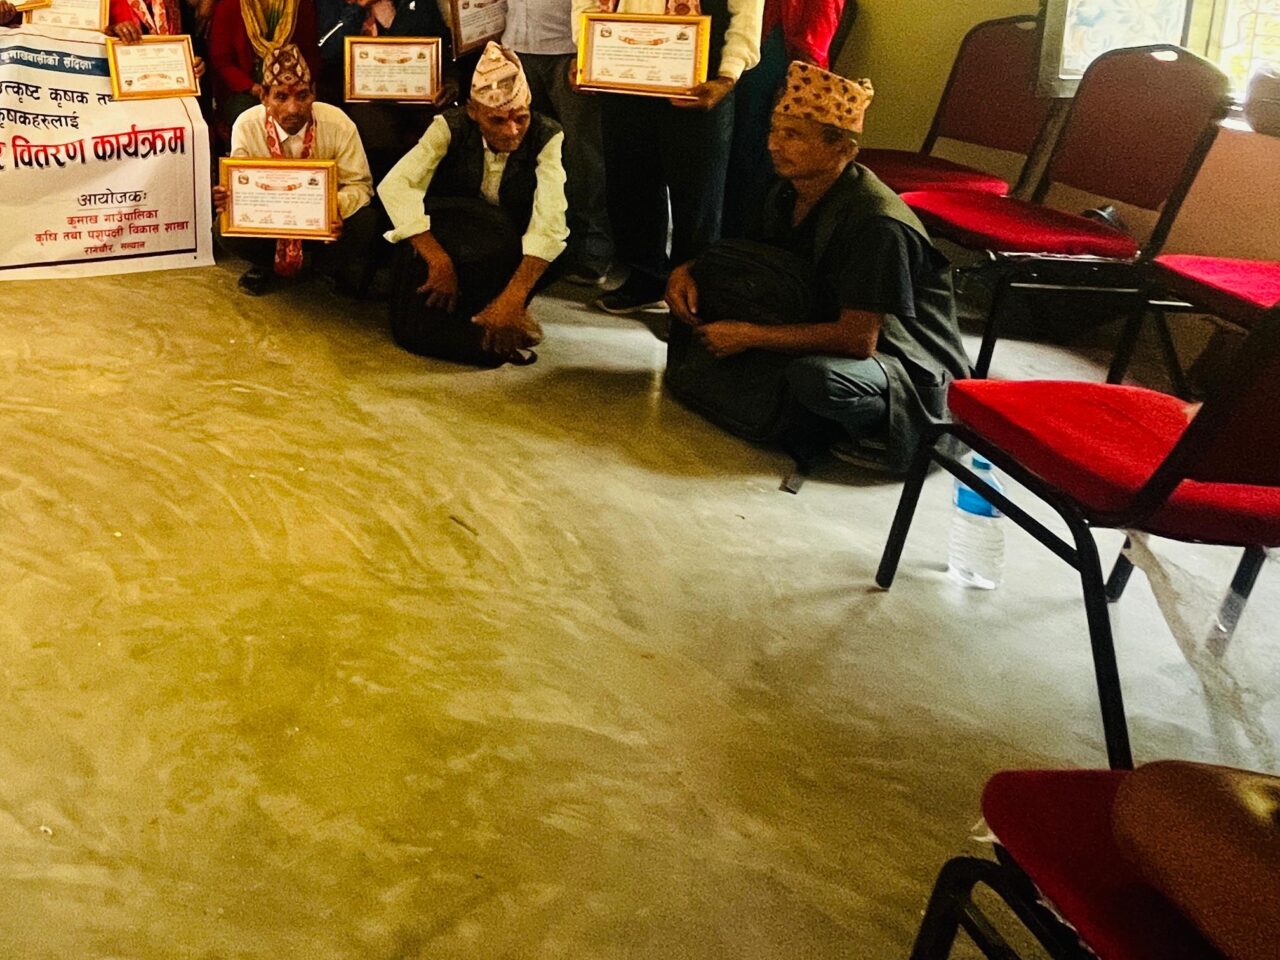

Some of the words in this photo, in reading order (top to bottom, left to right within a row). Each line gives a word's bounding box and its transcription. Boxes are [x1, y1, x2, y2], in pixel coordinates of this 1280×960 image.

[48, 87, 90, 108] कृषक
[11, 135, 86, 170] वितरण
[91, 123, 186, 162] कार्यक्रम
[34, 229, 58, 246] कृषि
[129, 222, 160, 235] विकास
[164, 220, 190, 233] शाखा
